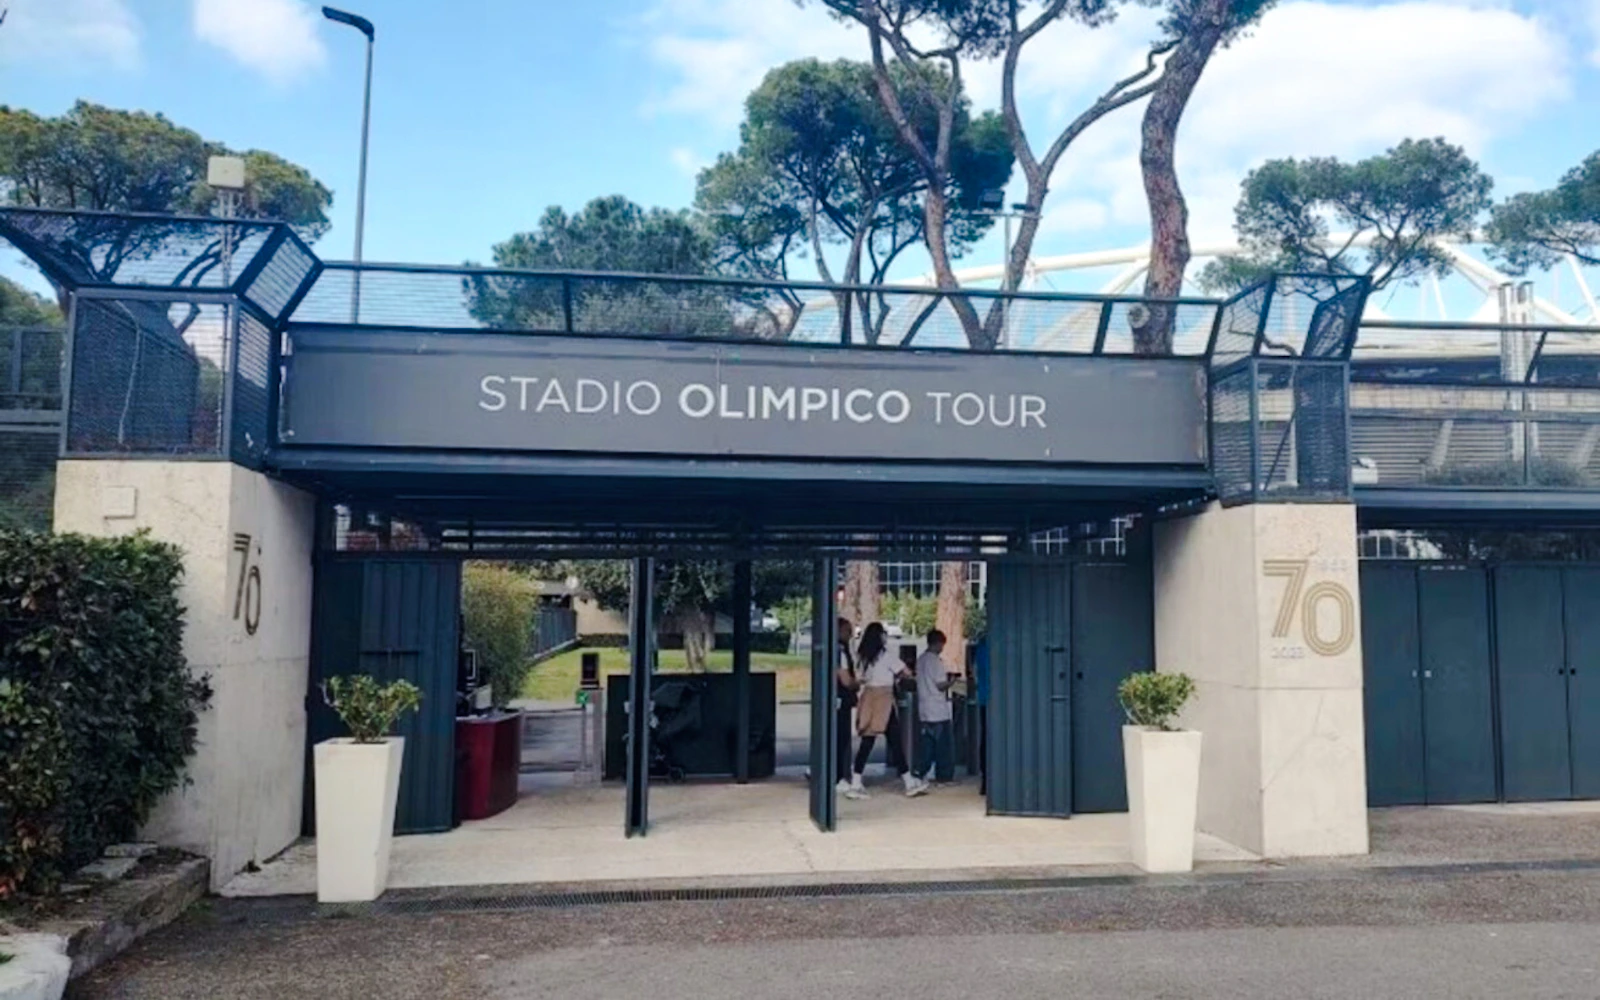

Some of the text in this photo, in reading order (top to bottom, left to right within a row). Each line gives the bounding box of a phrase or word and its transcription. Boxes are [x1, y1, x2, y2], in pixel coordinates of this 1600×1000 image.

[479, 375, 1047, 428] STADIO OLIMPICO TOUR
[233, 532, 261, 635] 70
[1263, 559, 1355, 657] 70
